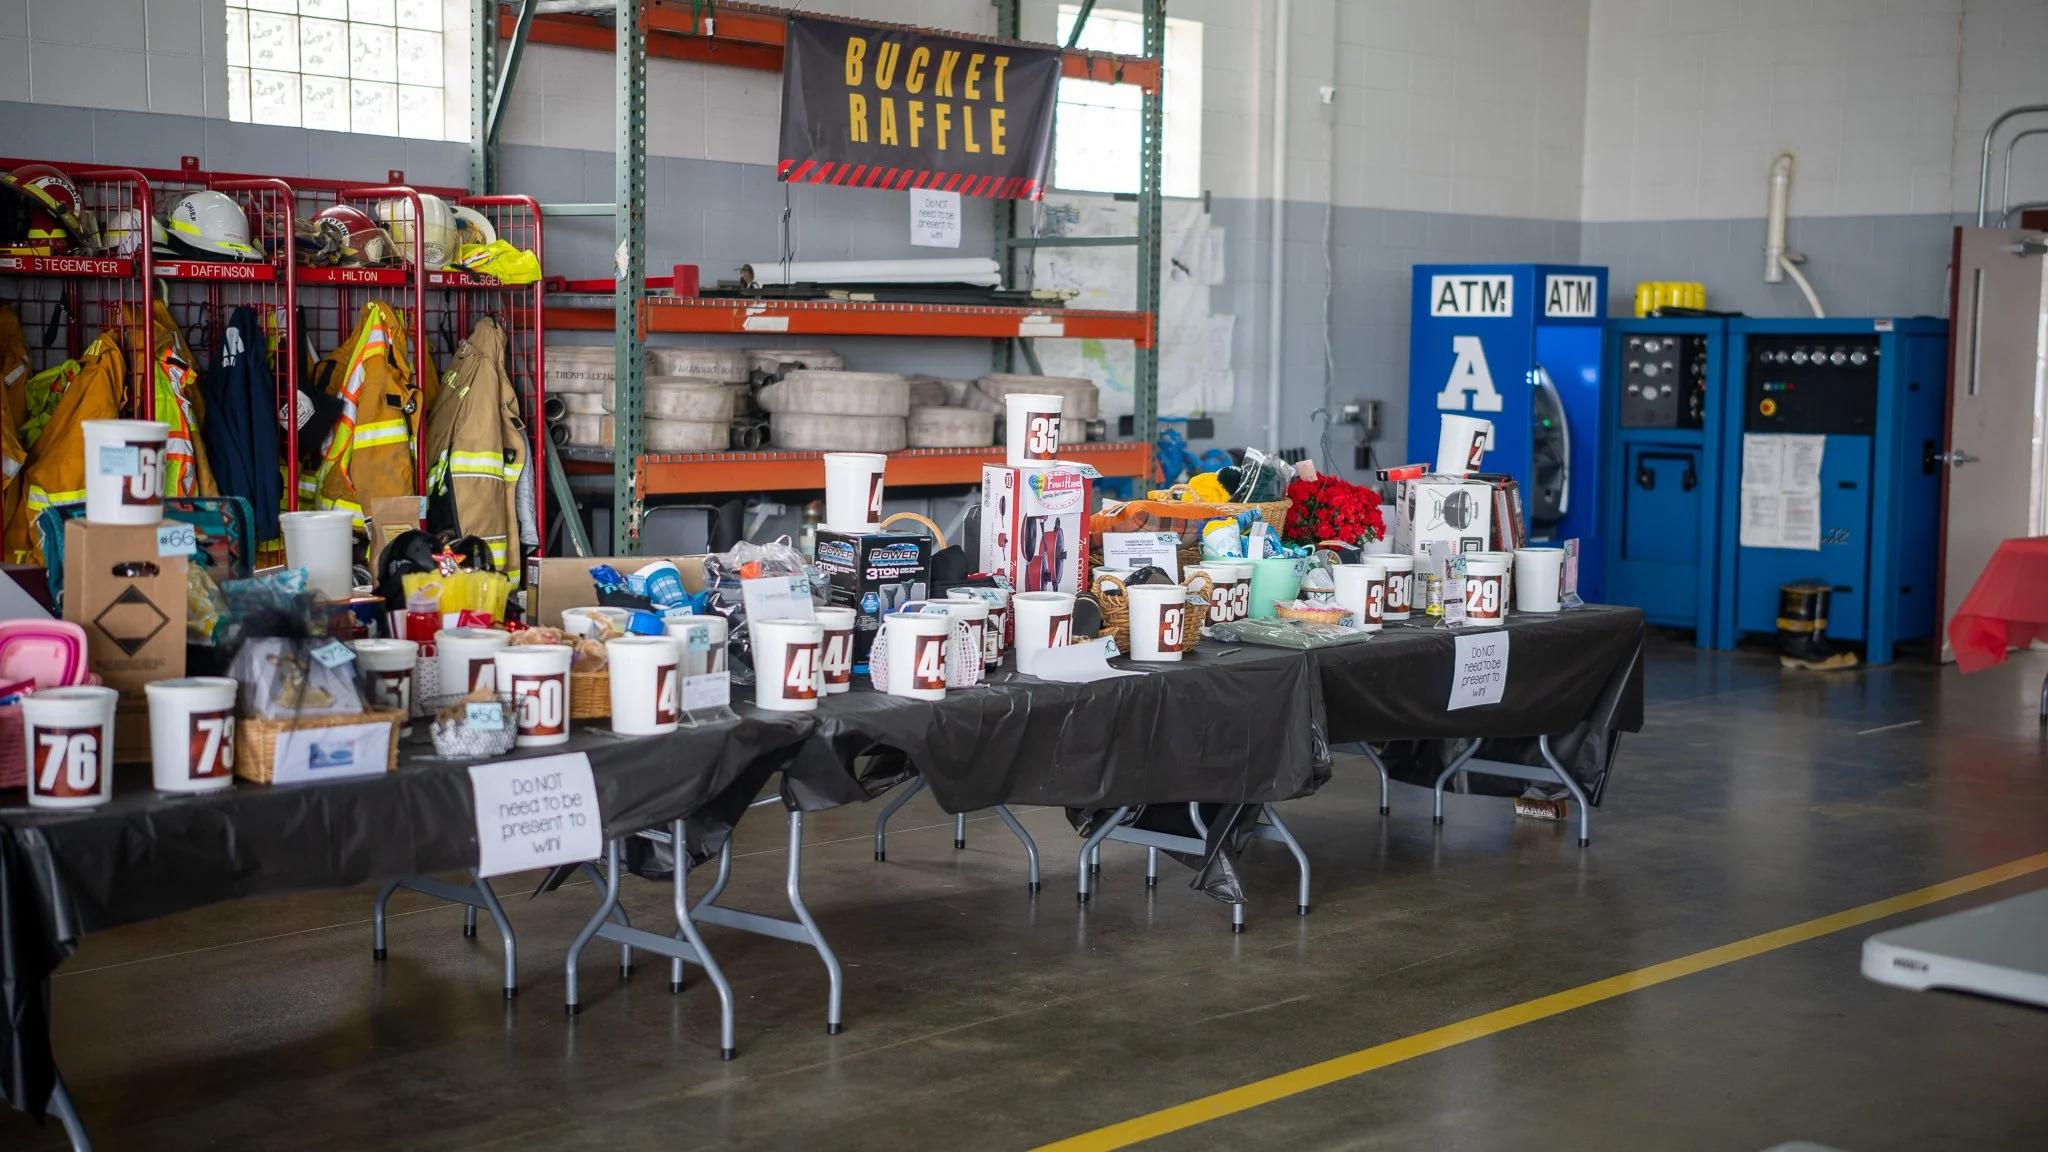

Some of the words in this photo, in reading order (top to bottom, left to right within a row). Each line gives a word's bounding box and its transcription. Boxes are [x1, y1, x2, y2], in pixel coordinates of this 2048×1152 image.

[846, 37, 1010, 102] BUCKET
[849, 93, 1006, 155] RAFFLE
[47, 177, 80, 204] CAPTAIN
[185, 202, 196, 222] CHIEF
[14, 258, 26, 269] B.
[34, 259, 118, 272] STEGEMEYER
[173, 264, 185, 276] T.
[191, 265, 255, 278] DAFFINSON
[328, 270, 336, 280] J.
[342, 271, 378, 281] HILTON
[446, 274, 455, 285] J.
[1436, 281, 1506, 313] ATM
[1547, 281, 1592, 313] ATM
[1437, 335, 1503, 413] A
[1029, 417, 1061, 454] 35
[130, 447, 166, 500] 66
[160, 529, 194, 547] #66
[869, 548, 919, 560] POWER
[823, 564, 838, 572] TON
[866, 568, 879, 580] 3
[879, 568, 899, 576] TON
[1211, 587, 1236, 622] 33
[1235, 583, 1251, 617] 3
[1369, 584, 1384, 618] 3
[1388, 575, 1413, 607] 30
[1467, 579, 1499, 612] 29
[823, 635, 853, 677] 44
[1471, 647, 1481, 658] Do
[1482, 645, 1495, 657] NOT
[1464, 661, 1482, 672] need
[1484, 660, 1491, 669] to
[1492, 659, 1501, 668] be
[1461, 673, 1490, 688] present
[1493, 672, 1499, 681] to
[470, 707, 501, 723] #50
[515, 680, 562, 728] 50
[197, 715, 236, 774] 73
[39, 734, 97, 790] 76
[513, 779, 533, 795] Do
[536, 773, 562, 791] NOT
[500, 799, 539, 818] need
[543, 796, 560, 810] to
[562, 793, 582, 808] be
[502, 815, 563, 841] present
[569, 813, 586, 827] to
